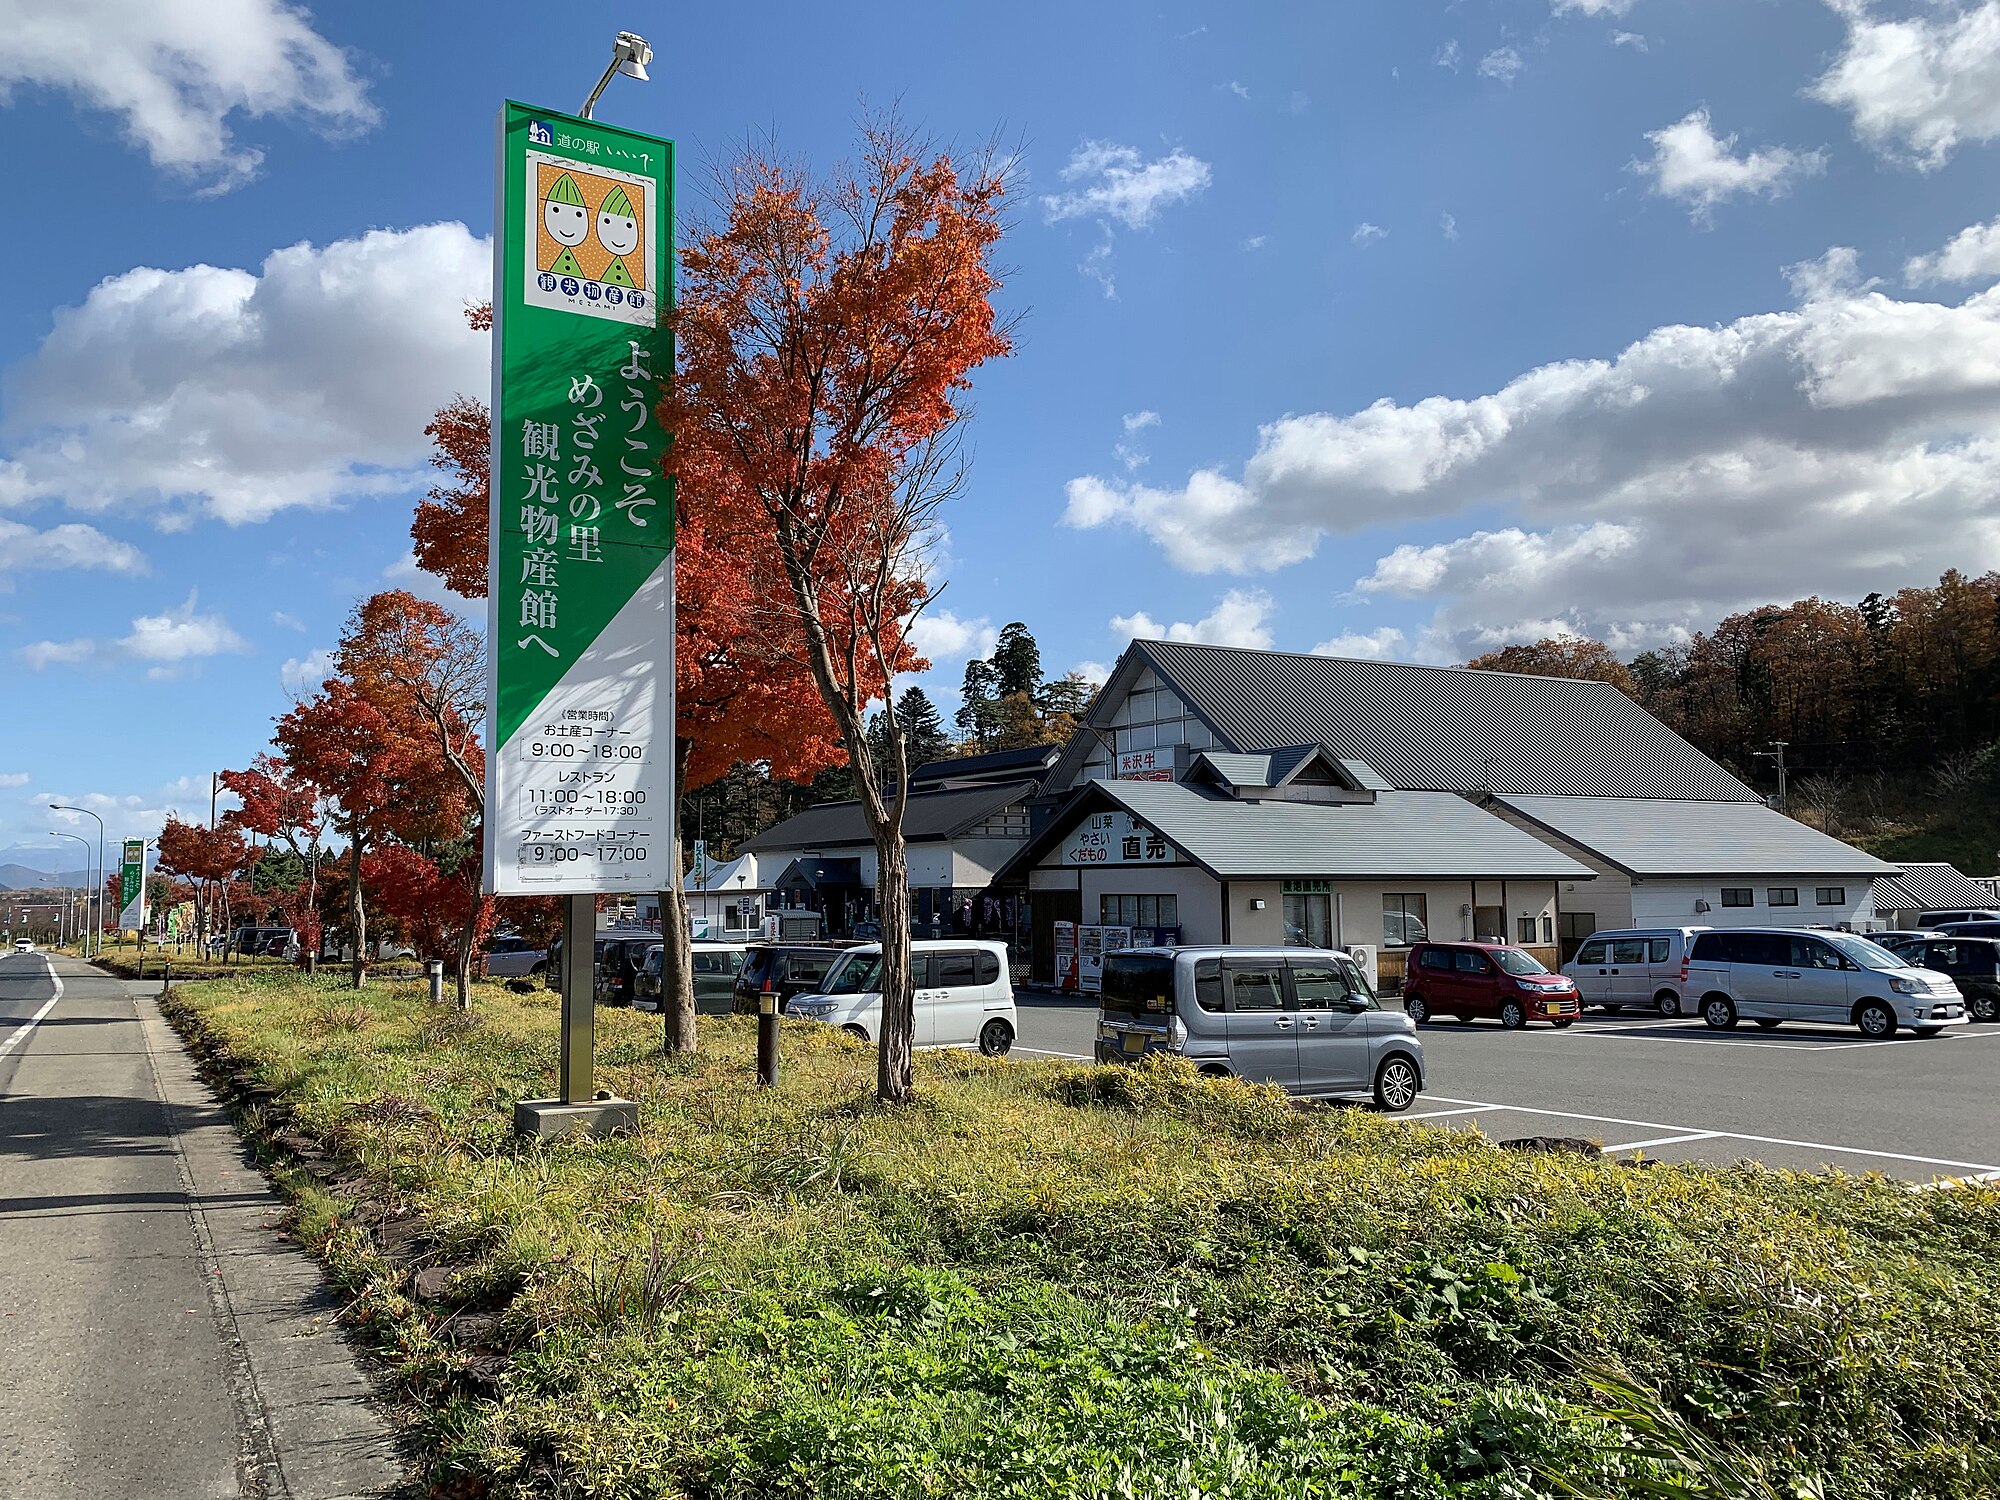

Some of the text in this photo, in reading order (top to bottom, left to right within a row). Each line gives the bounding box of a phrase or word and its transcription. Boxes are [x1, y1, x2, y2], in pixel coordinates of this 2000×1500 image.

[557, 132, 600, 156] 道の駅
[539, 273, 644, 309] 観光物産館
[614, 340, 657, 527] ようこそ
[566, 374, 607, 563] めざみの里
[517, 418, 561, 658] 観光物産館へ
[544, 725, 631, 738] お土産コーナー
[1122, 753, 1156, 770] 米沢牛
[558, 771, 616, 783] レストラン
[1091, 815, 1113, 829] 山菜
[521, 830, 650, 842] ファーストフードコーナー
[1080, 832, 1111, 846] やさい
[1069, 847, 1108, 862] くだもの
[1122, 835, 1167, 860] 直売
